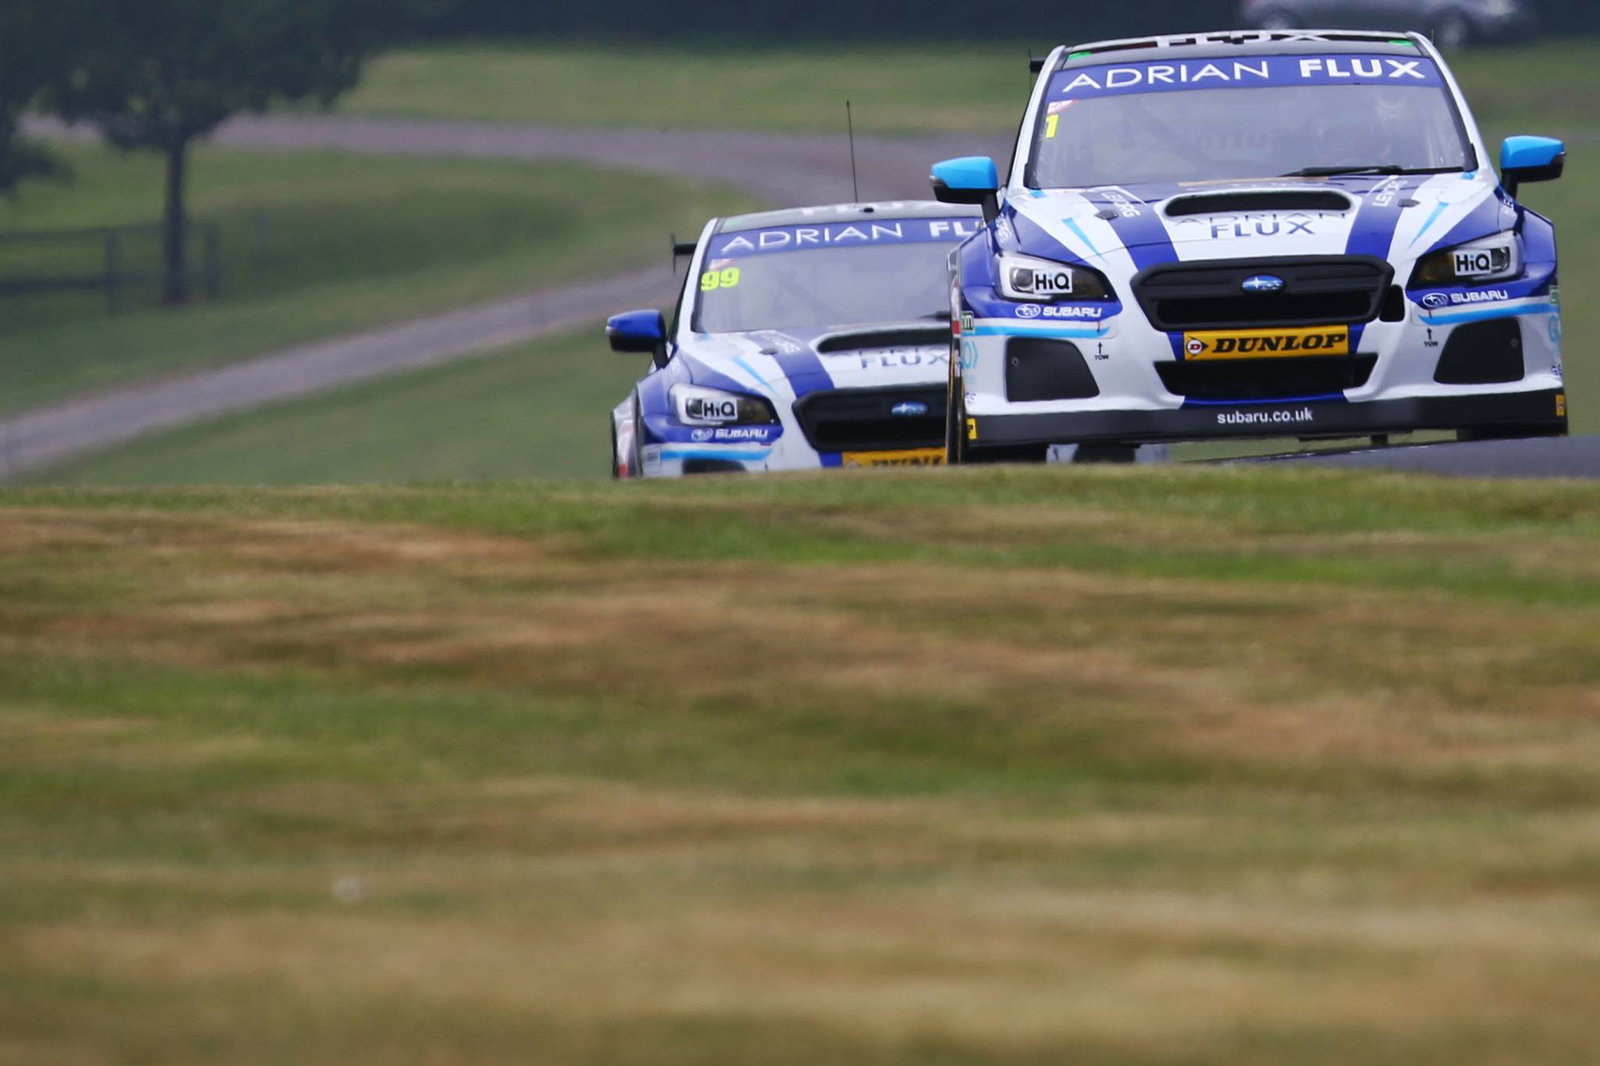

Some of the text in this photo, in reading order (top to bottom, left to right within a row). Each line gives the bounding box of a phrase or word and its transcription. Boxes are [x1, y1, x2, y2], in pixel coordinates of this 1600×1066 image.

[1062, 58, 1426, 93] ADRIAN FLUX
[1045, 114, 1059, 138] 1
[721, 222, 903, 252] ADRIAN
[929, 220, 985, 238] FL
[1210, 220, 1315, 239] FLUX
[1456, 253, 1490, 272] HiQ
[700, 266, 740, 291] 99
[1035, 272, 1070, 290] HiQ
[1450, 289, 1509, 303] SUBARU
[1042, 306, 1102, 318] SUBARU
[1212, 333, 1347, 354] DUNLOP
[860, 353, 950, 369] FLUX
[702, 401, 736, 417] HiQ
[1217, 406, 1313, 424] subaru.co.uk
[715, 428, 768, 439] SUBARU
